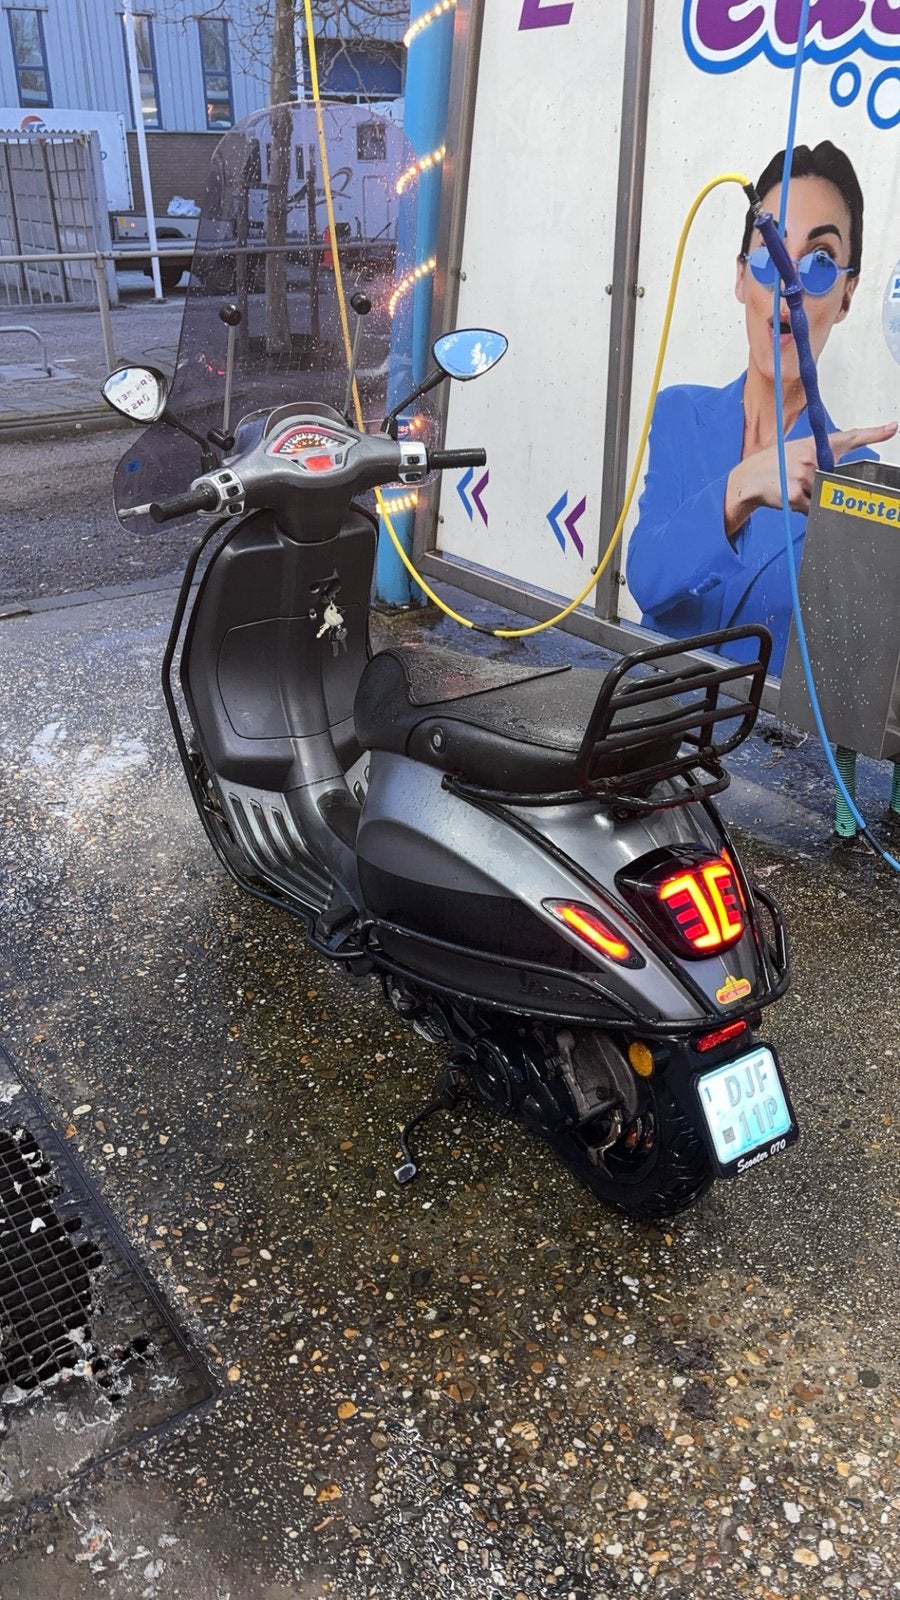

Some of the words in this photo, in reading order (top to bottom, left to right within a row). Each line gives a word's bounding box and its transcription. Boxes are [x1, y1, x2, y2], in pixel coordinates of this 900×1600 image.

[831, 488, 900, 522] Borste
[724, 1059, 767, 1107] DJF
[738, 1097, 778, 1141] 11P
[737, 1151, 768, 1173] Scooter
[770, 1138, 786, 1155] 070
